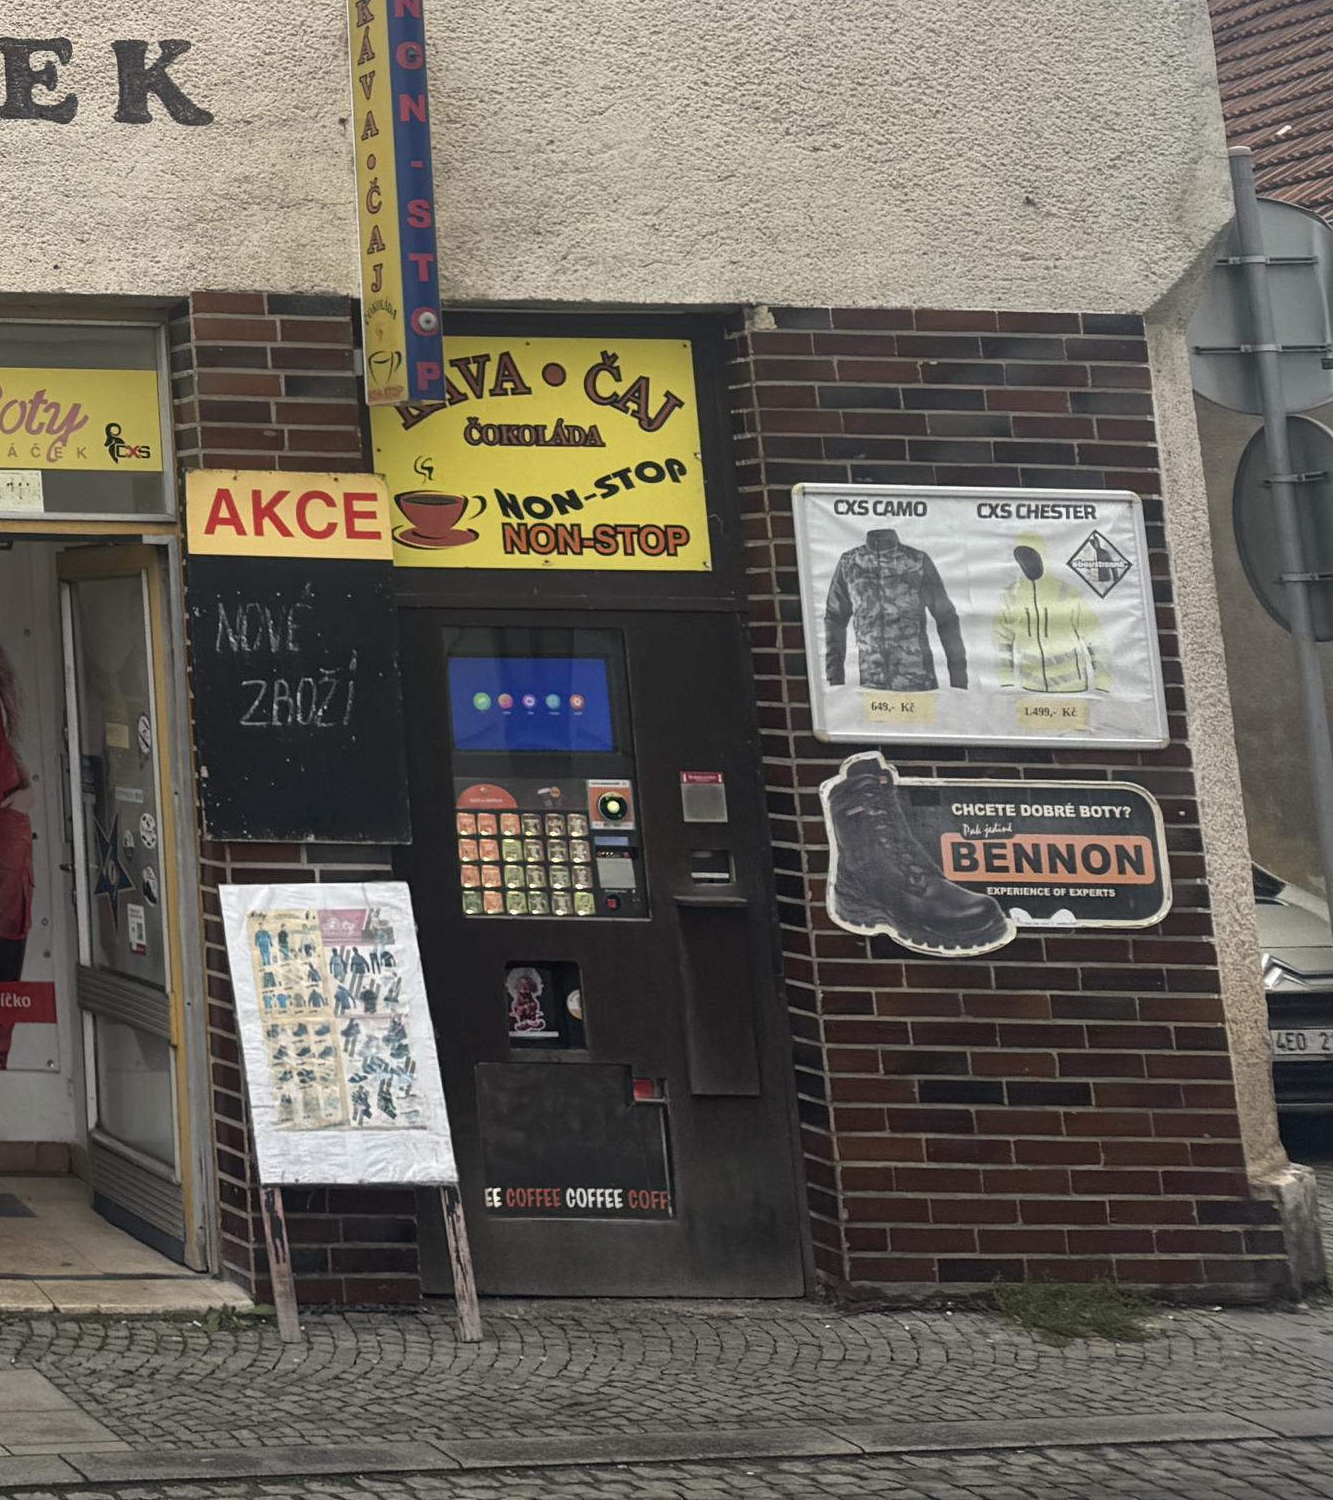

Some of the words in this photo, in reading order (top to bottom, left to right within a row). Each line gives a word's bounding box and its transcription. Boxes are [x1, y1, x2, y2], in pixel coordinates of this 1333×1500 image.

[364, 177, 386, 293] ČAJ
[583, 350, 686, 432] ČAJ
[464, 417, 606, 447] ČOKOLÁDA
[114, 445, 151, 459] CXS
[494, 458, 687, 520] NON-STOP
[204, 488, 382, 540] AKCE
[833, 499, 870, 516] CXS
[872, 500, 928, 517] CAMO
[977, 503, 1013, 519] CXS
[1015, 503, 1097, 520] CHESTER
[501, 522, 690, 557] NON-STOP
[216, 582, 313, 652] NOVÉ
[239, 650, 358, 728] ZBOŽÍ
[870, 701, 895, 714] 649,-
[900, 702, 916, 713] Kč
[1062, 707, 1077, 718] Kč
[951, 803, 1016, 816] CHCETE
[1020, 802, 1076, 818] DOBRÉ
[1080, 805, 1132, 818] BOTY?
[950, 841, 1146, 876] BENNON
[987, 887, 1050, 897] EXPERIENCE
[1053, 887, 1067, 897] OF
[1069, 888, 1116, 897] EXPERTS
[505, 1187, 561, 1208] COFFEE
[566, 1187, 624, 1209] COFFEE
